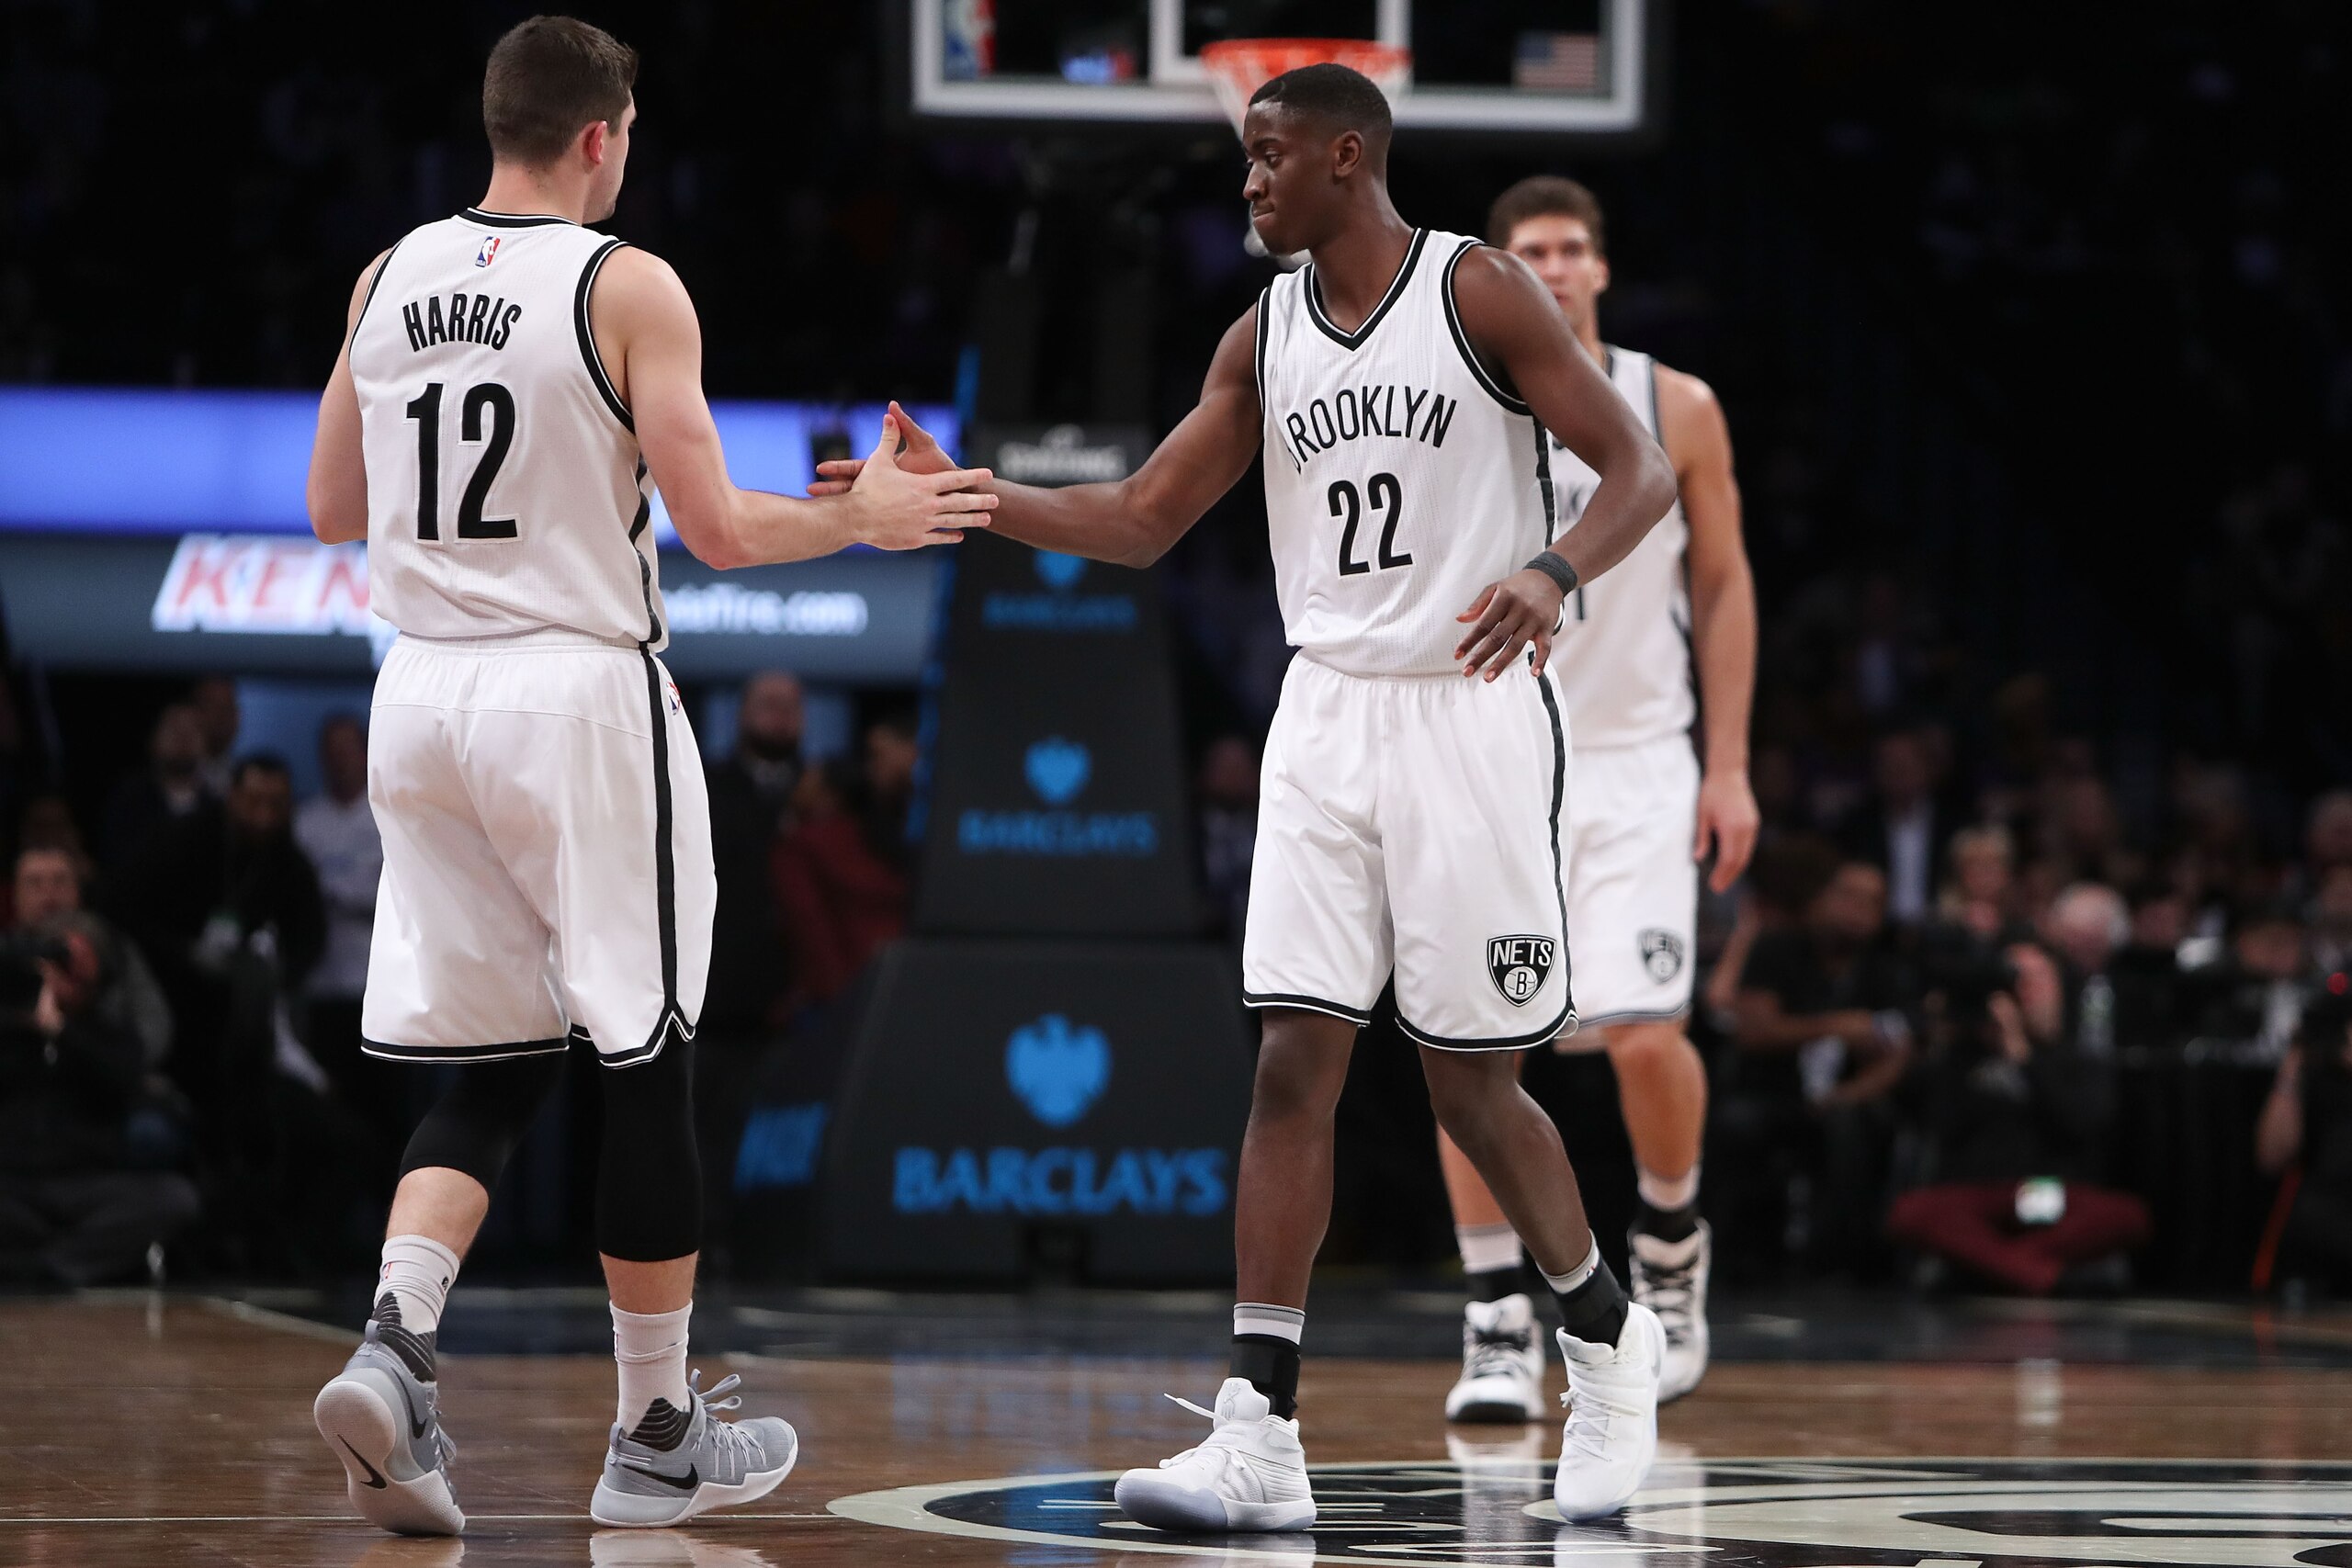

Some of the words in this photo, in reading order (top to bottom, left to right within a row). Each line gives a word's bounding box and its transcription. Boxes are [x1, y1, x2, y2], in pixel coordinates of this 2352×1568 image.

[402, 293, 522, 353] HARRIS
[406, 382, 518, 541] 12
[1287, 385, 1458, 475] ROOKLYN
[1328, 471, 1413, 576] 22
[160, 536, 369, 625] KEN
[1493, 939, 1553, 967] NETS
[893, 1146, 1228, 1216] BARCLAYS
